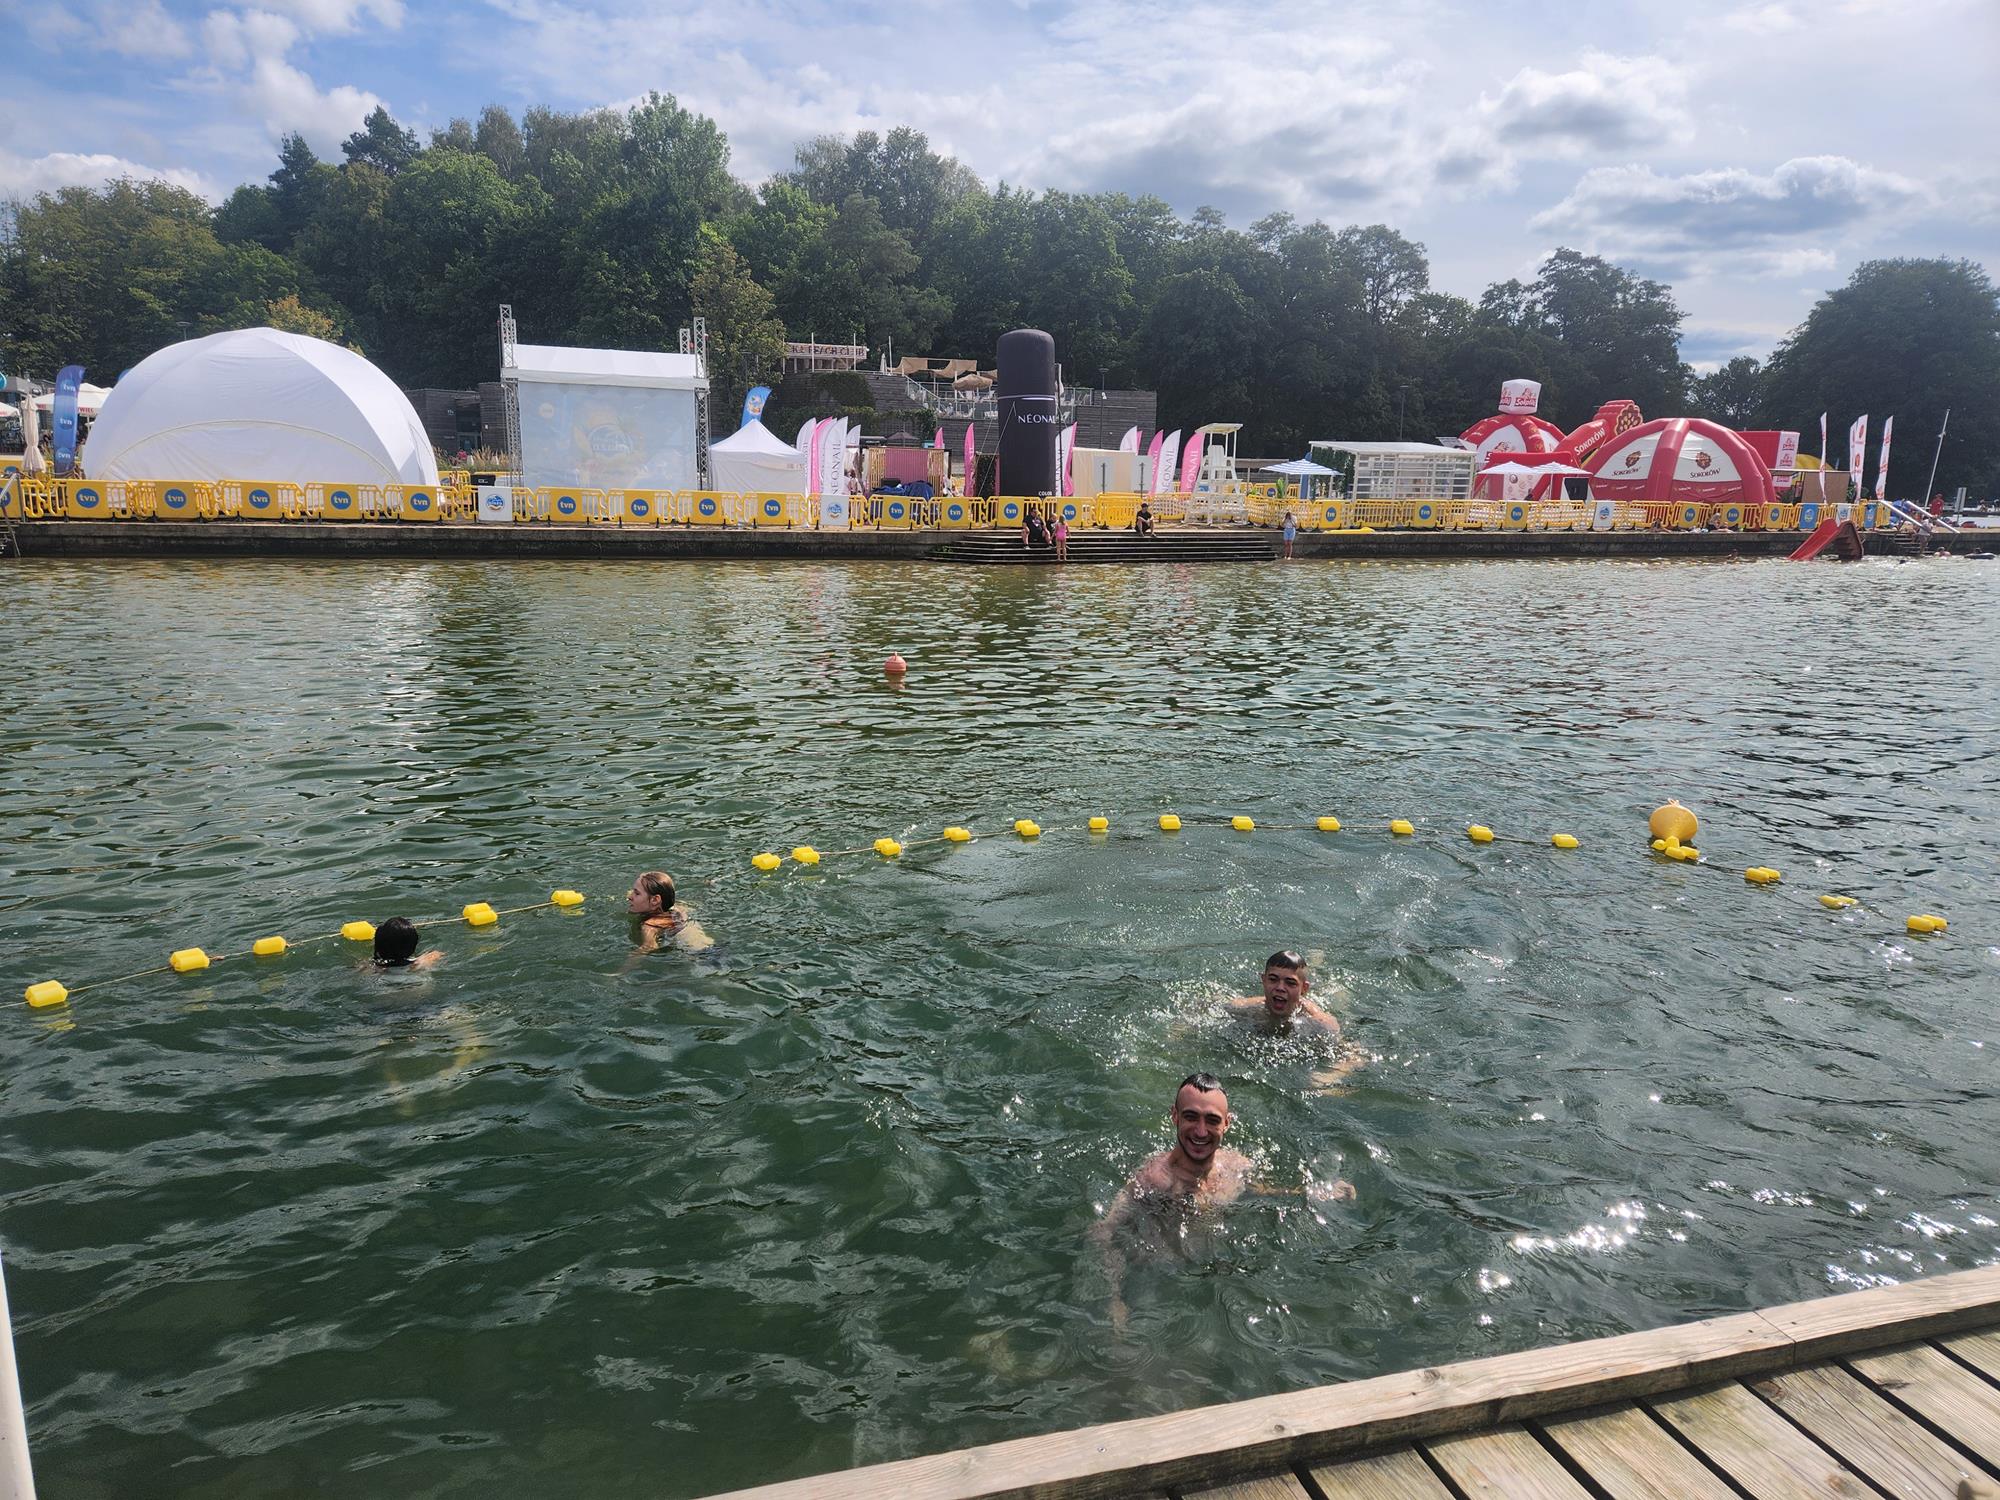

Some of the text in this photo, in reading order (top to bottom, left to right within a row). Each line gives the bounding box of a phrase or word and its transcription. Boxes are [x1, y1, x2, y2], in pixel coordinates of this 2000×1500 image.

[63, 383, 76, 392] tvn
[60, 417, 72, 426] tvn
[58, 451, 71, 459] tvn
[79, 494, 97, 502] tvn
[167, 494, 184, 502] tvn
[252, 494, 269, 503] tvn
[333, 495, 349, 504] tvn
[413, 497, 428, 506] tvn
[560, 501, 574, 509] tvn
[633, 503, 647, 511] tvn
[701, 503, 714, 511] tvn
[765, 504, 779, 512] tvn
[891, 506, 903, 514] tvn
[950, 508, 962, 516] tvn
[1005, 507, 1018, 515] tvn
